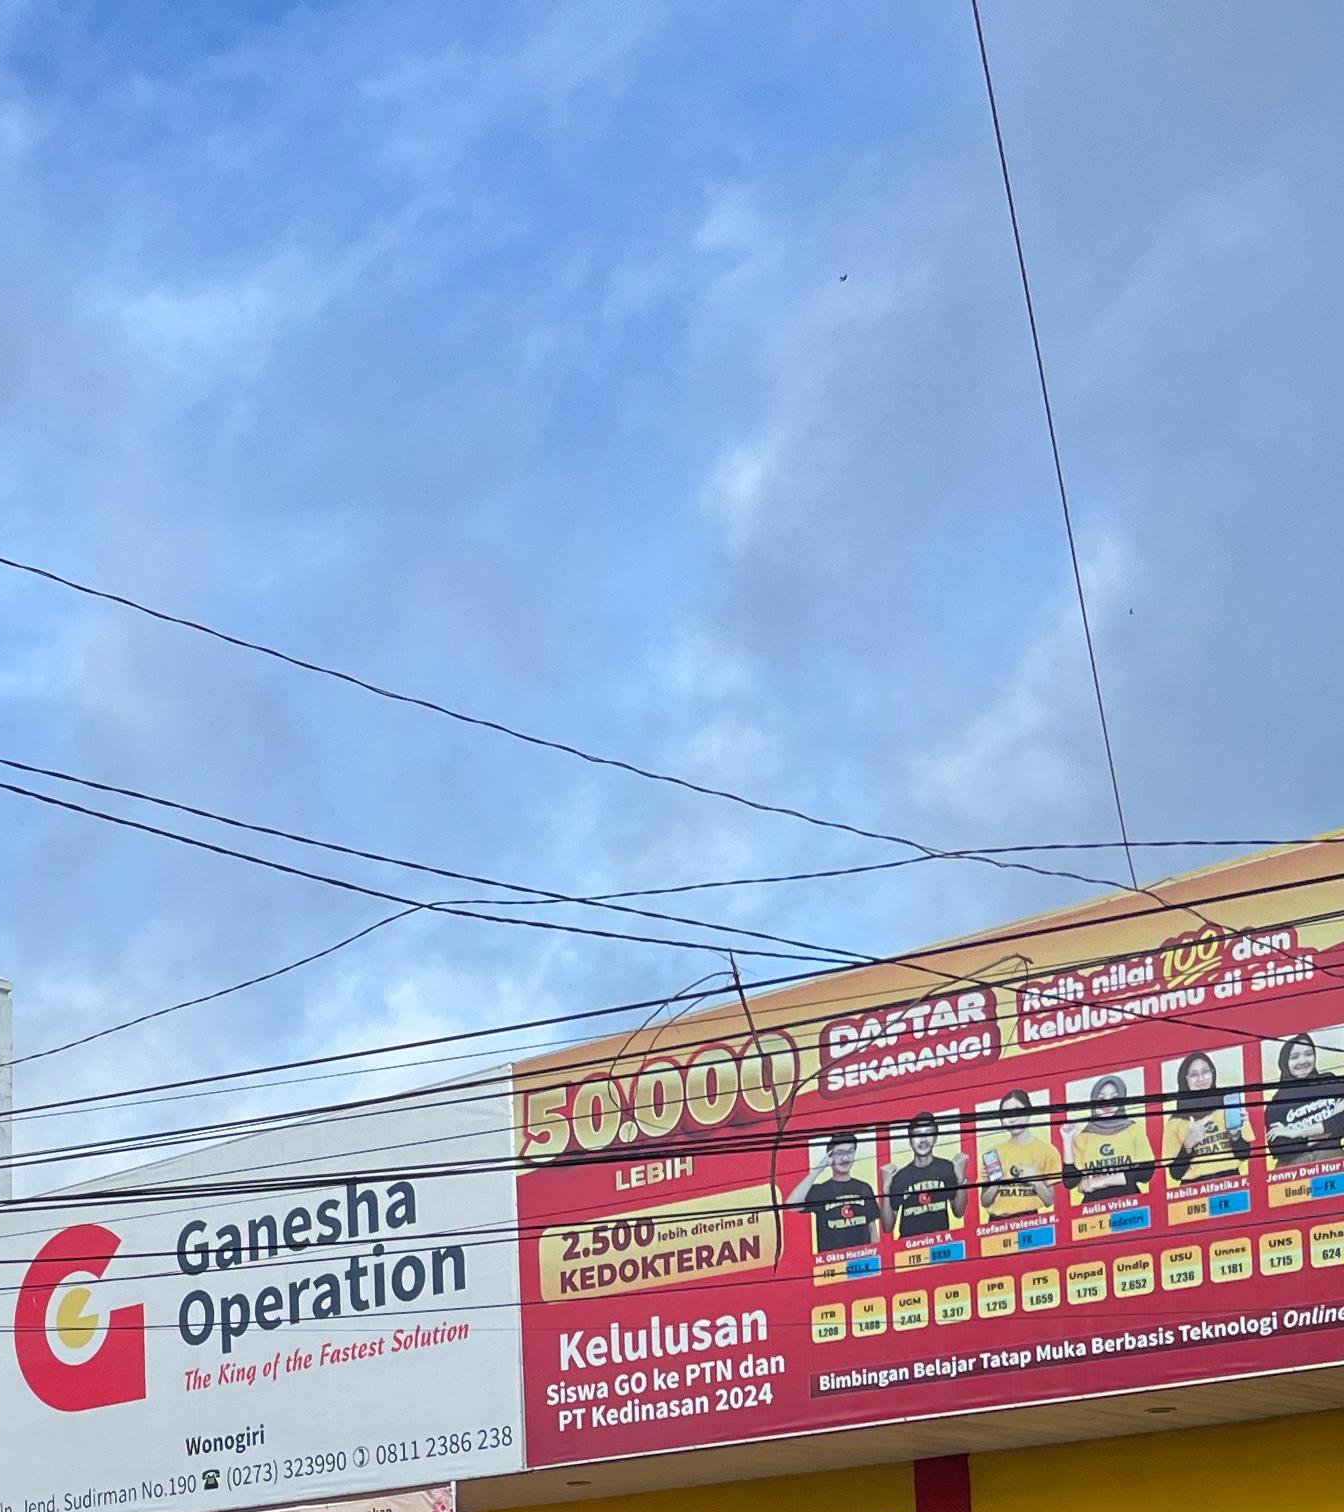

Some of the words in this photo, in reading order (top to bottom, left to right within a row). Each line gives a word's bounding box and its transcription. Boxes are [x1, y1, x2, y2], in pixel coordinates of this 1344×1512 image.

[1022, 977, 1084, 1012] Raih
[1092, 957, 1154, 996] nilai
[1160, 929, 1218, 976] 100
[1232, 932, 1290, 961] dan
[1023, 985, 1205, 1042] kelulusanmu
[1214, 969, 1243, 999] di
[828, 992, 986, 1058] DAFTAR
[828, 1032, 992, 1092] SEKARANG!
[520, 1034, 795, 1164] 50.000
[615, 1155, 694, 1191] LEBIH
[1266, 1171, 1298, 1184] Jenny
[1322, 1163, 1340, 1175] Nur
[1166, 1188, 1198, 1200] Nabila
[1187, 1203, 1207, 1216] UNS
[177, 1179, 417, 1276] Ganesha
[562, 1217, 655, 1262] 2.500
[657, 1226, 688, 1243] lebih
[691, 1218, 745, 1237] diterima
[748, 1213, 759, 1226] di
[906, 1236, 934, 1248] Garvin
[976, 1224, 1009, 1237] Stefani
[1010, 1218, 1043, 1231] Valencia
[1268, 1237, 1293, 1249] UNS
[560, 1234, 761, 1294] KEDOKTERAN
[826, 1252, 845, 1262] Okto
[1117, 1260, 1150, 1273] Undip
[1170, 1251, 1193, 1262] USU
[987, 1282, 1004, 1292] IPB
[1032, 1275, 1049, 1286] ITS
[1069, 1268, 1104, 1281] Unpad
[179, 1245, 467, 1354] Operation
[864, 1305, 874, 1313] UI
[899, 1297, 921, 1308] UGM
[945, 1290, 960, 1300] UB
[559, 1307, 768, 1371] Kelulusan
[819, 1361, 909, 1392] Bimbingan
[913, 1351, 976, 1380] Belajar
[979, 1344, 1031, 1371] Tatap
[1035, 1338, 1086, 1360] Muka
[1091, 1326, 1175, 1354] Berbasis
[1178, 1311, 1279, 1346] Teknologi
[1282, 1303, 1344, 1331] Online
[185, 1368, 211, 1392] The
[218, 1359, 257, 1387] King
[264, 1353, 281, 1383] of
[285, 1348, 313, 1371] the
[319, 1336, 385, 1366] Fastest
[391, 1321, 470, 1353] Solution
[546, 1379, 608, 1406] Siswa
[614, 1373, 647, 1398] GO
[653, 1367, 679, 1392] ke
[685, 1361, 733, 1387] PTN
[738, 1352, 785, 1377] dan
[558, 1408, 587, 1432] PT
[591, 1389, 709, 1427] Kedinasan
[715, 1382, 773, 1411] 2024
[186, 1425, 266, 1457] Wonogiri
[64, 1482, 138, 1512] Sudirman
[141, 1473, 197, 1501] No.190
[226, 1459, 280, 1490] (0273)
[283, 1451, 347, 1480] 323990
[375, 1440, 420, 1467] 0811
[425, 1433, 473, 1459] 2386
[477, 1425, 514, 1450] 238
